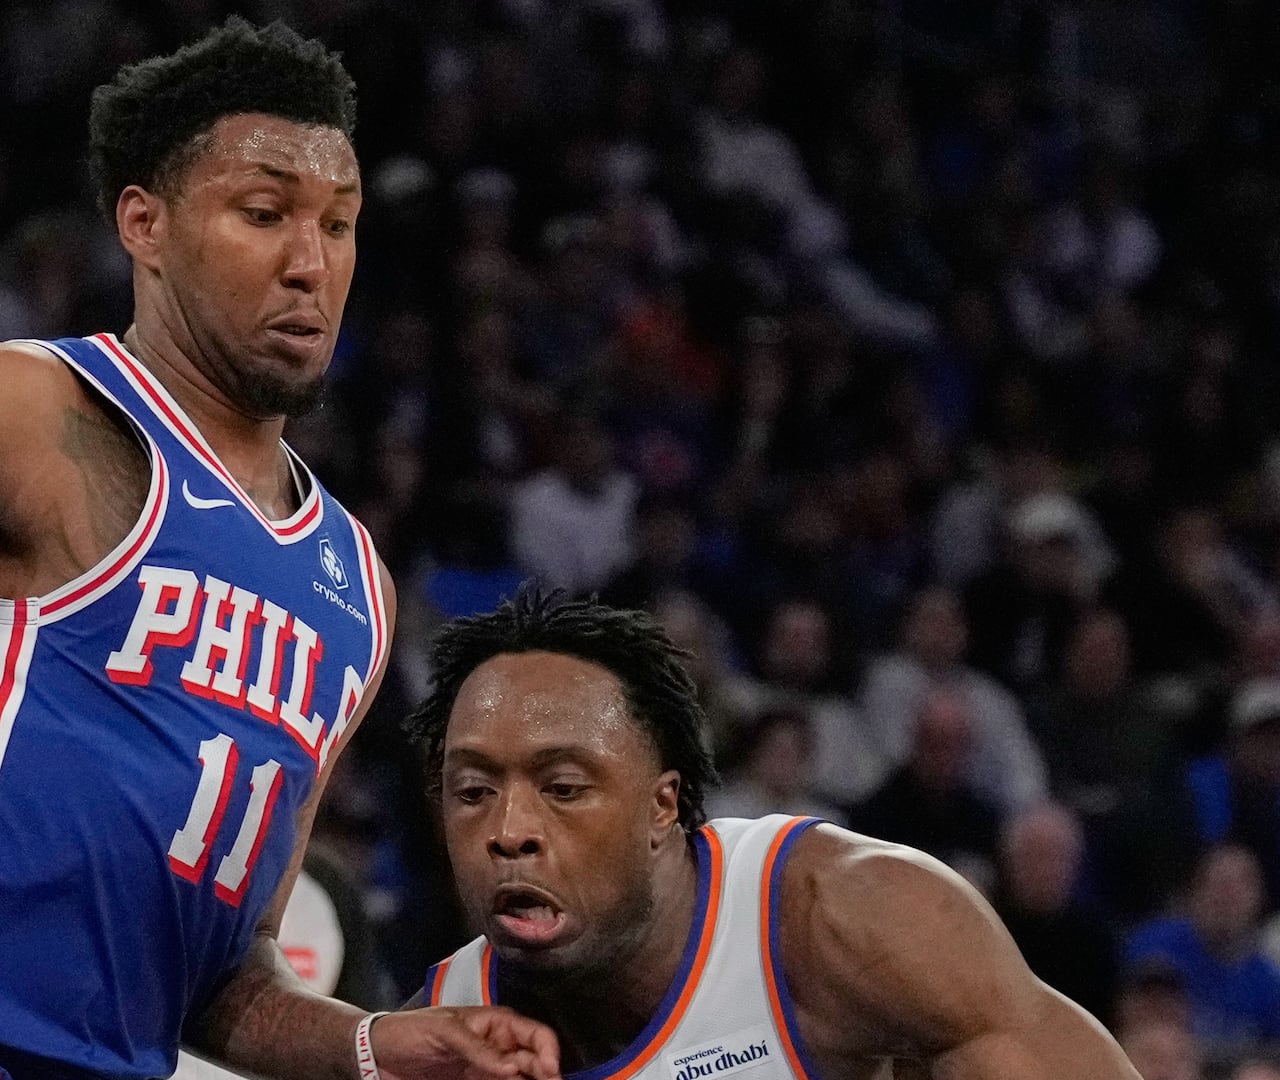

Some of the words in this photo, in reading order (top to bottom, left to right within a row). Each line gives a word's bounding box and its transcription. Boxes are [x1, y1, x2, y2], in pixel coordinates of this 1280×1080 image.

[312, 580, 367, 626] crypto.com
[167, 732, 284, 908] 11
[673, 1045, 724, 1066] experience
[715, 1040, 769, 1071] dhabi
